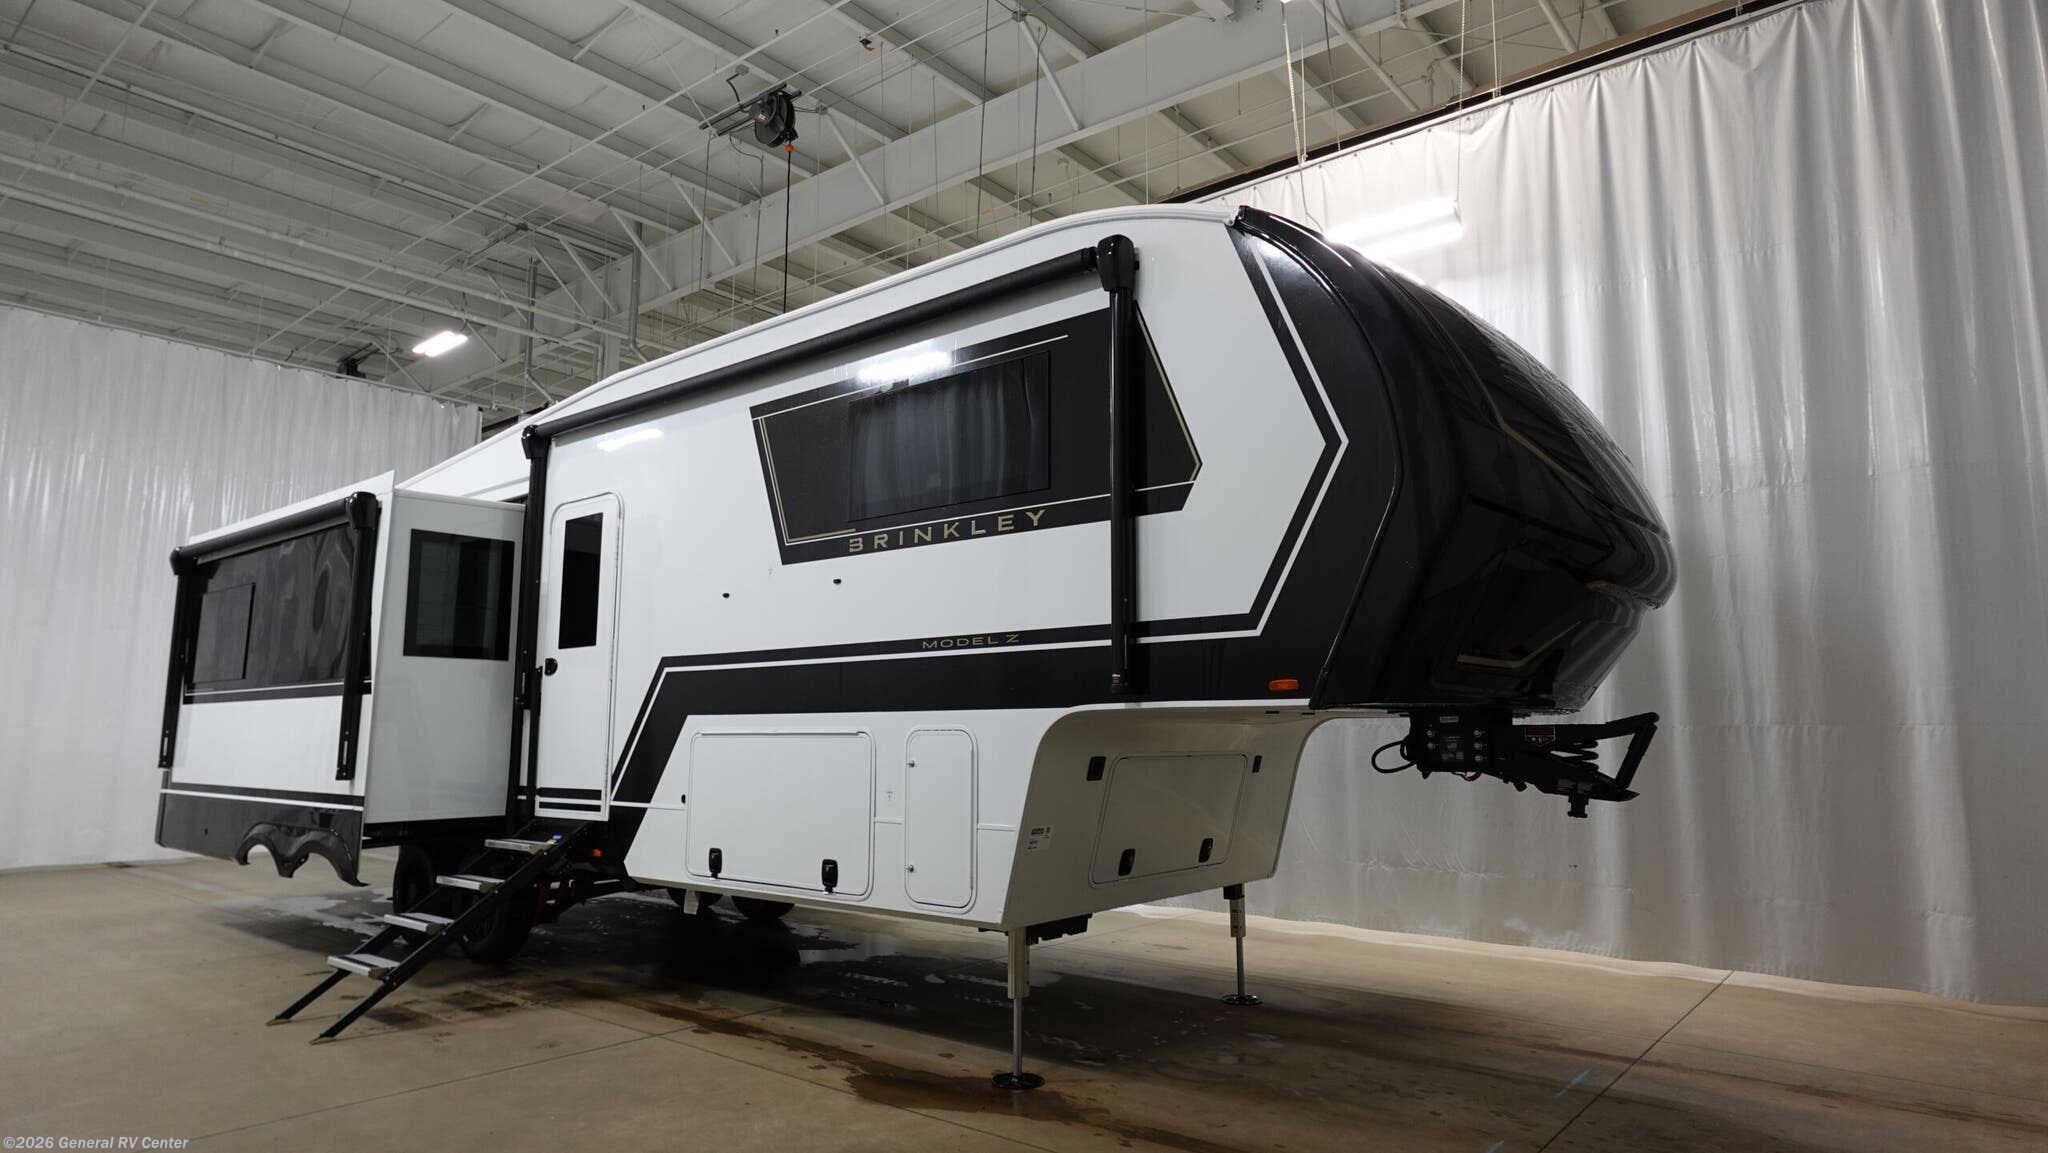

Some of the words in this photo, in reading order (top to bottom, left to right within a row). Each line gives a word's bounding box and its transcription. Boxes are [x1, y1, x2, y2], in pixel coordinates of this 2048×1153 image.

[848, 509, 1046, 552] BRINKLEY
[922, 636, 998, 649] MODEL
[1006, 633, 1020, 643] Z
